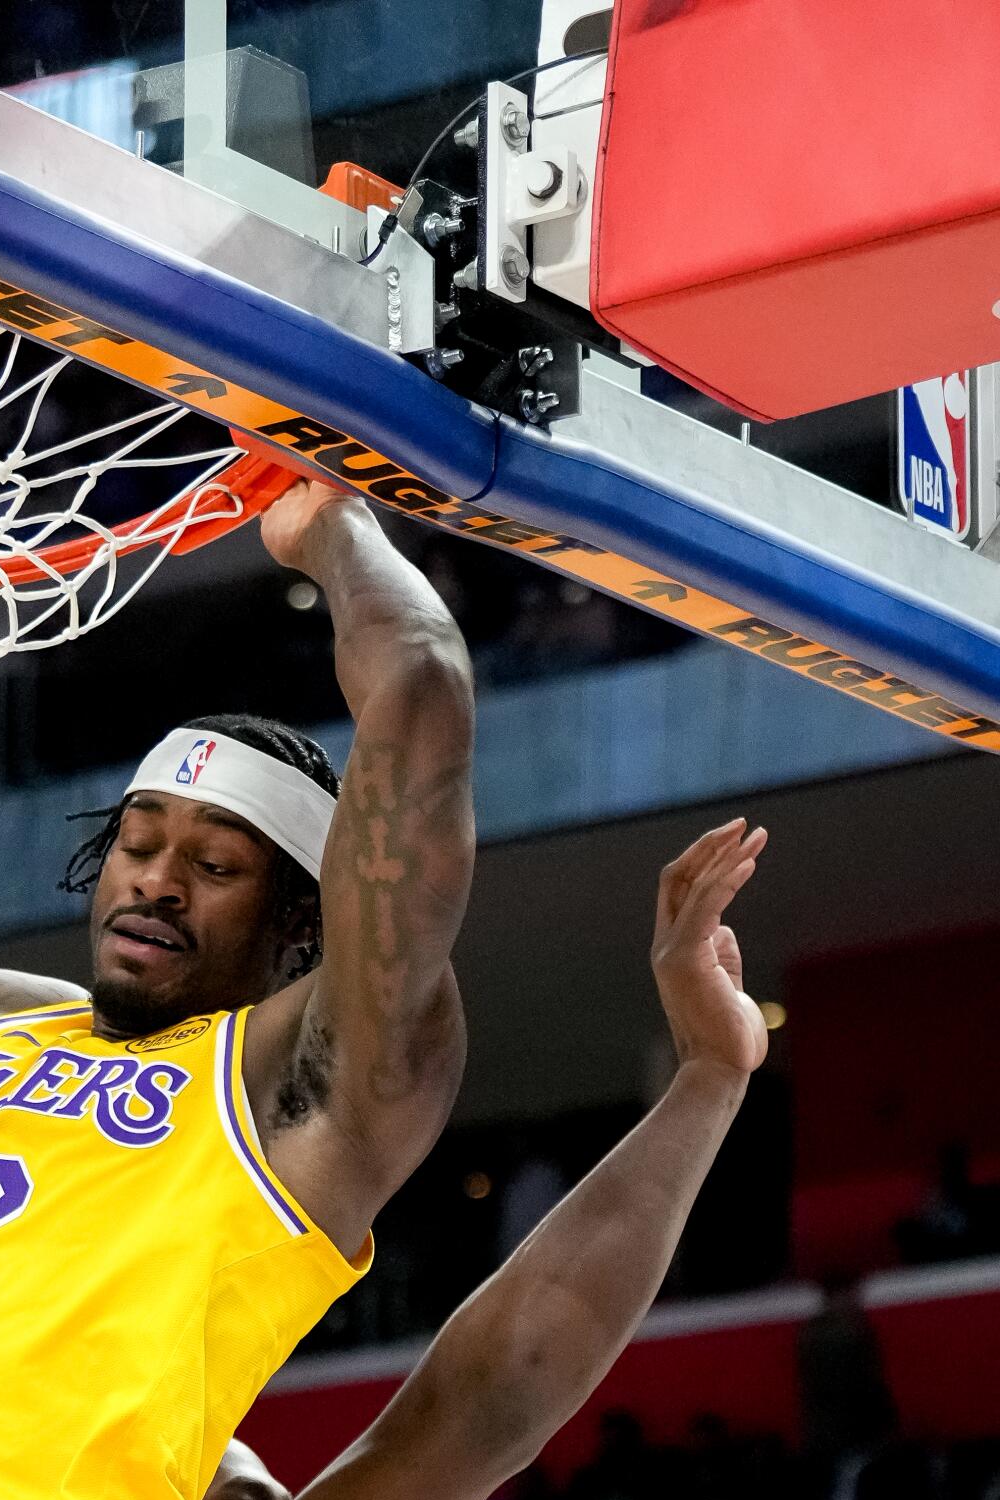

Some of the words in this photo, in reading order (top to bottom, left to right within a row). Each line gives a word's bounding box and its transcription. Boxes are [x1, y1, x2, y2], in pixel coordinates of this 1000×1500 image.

[254, 415, 609, 556] RUGIET
[911, 454, 945, 514] NBA
[707, 617, 1000, 739] RUGIET
